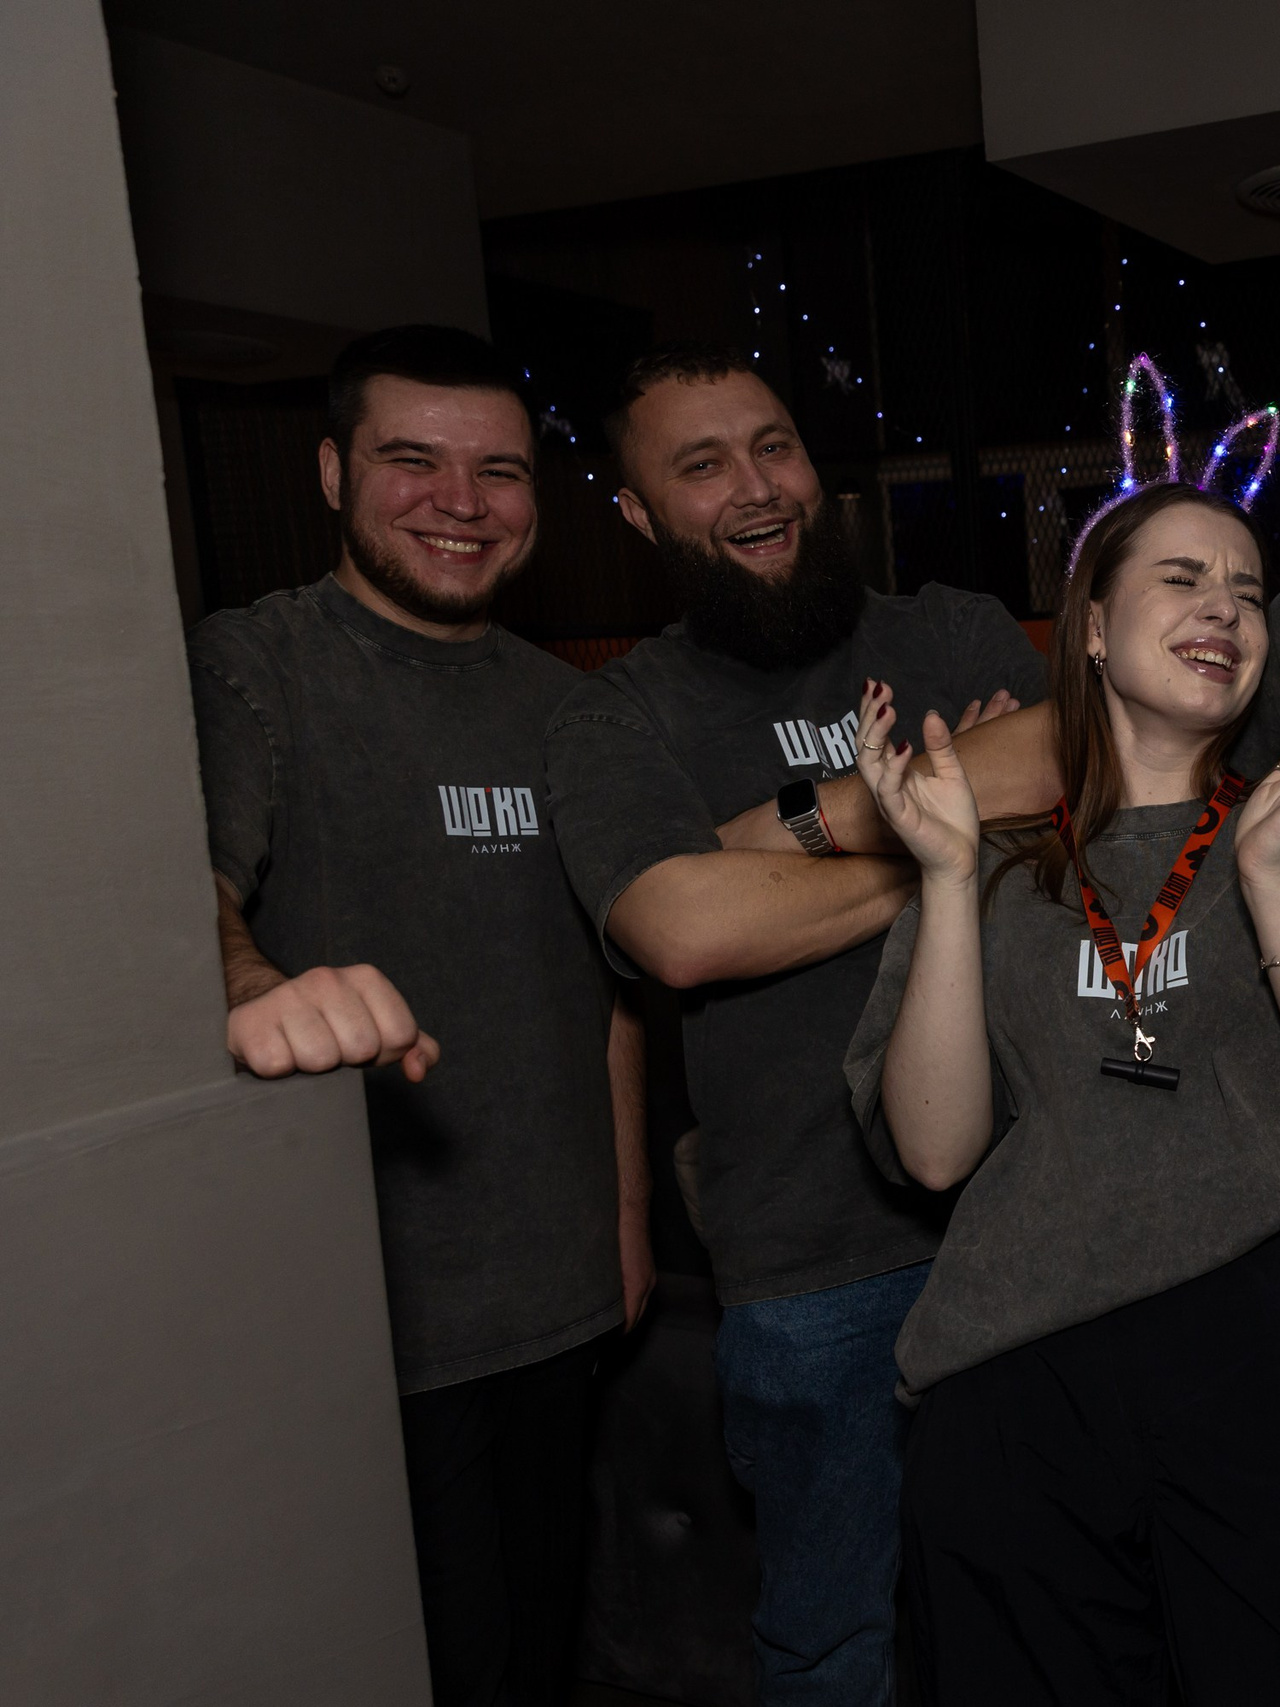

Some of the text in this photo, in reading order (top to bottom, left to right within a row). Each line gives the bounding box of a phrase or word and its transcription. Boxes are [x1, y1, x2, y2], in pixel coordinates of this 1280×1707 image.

[438, 785, 540, 837] ШОКО
[471, 843, 522, 854] ЛАУНЖ
[1110, 1000, 1168, 1019] ЛНЖ
